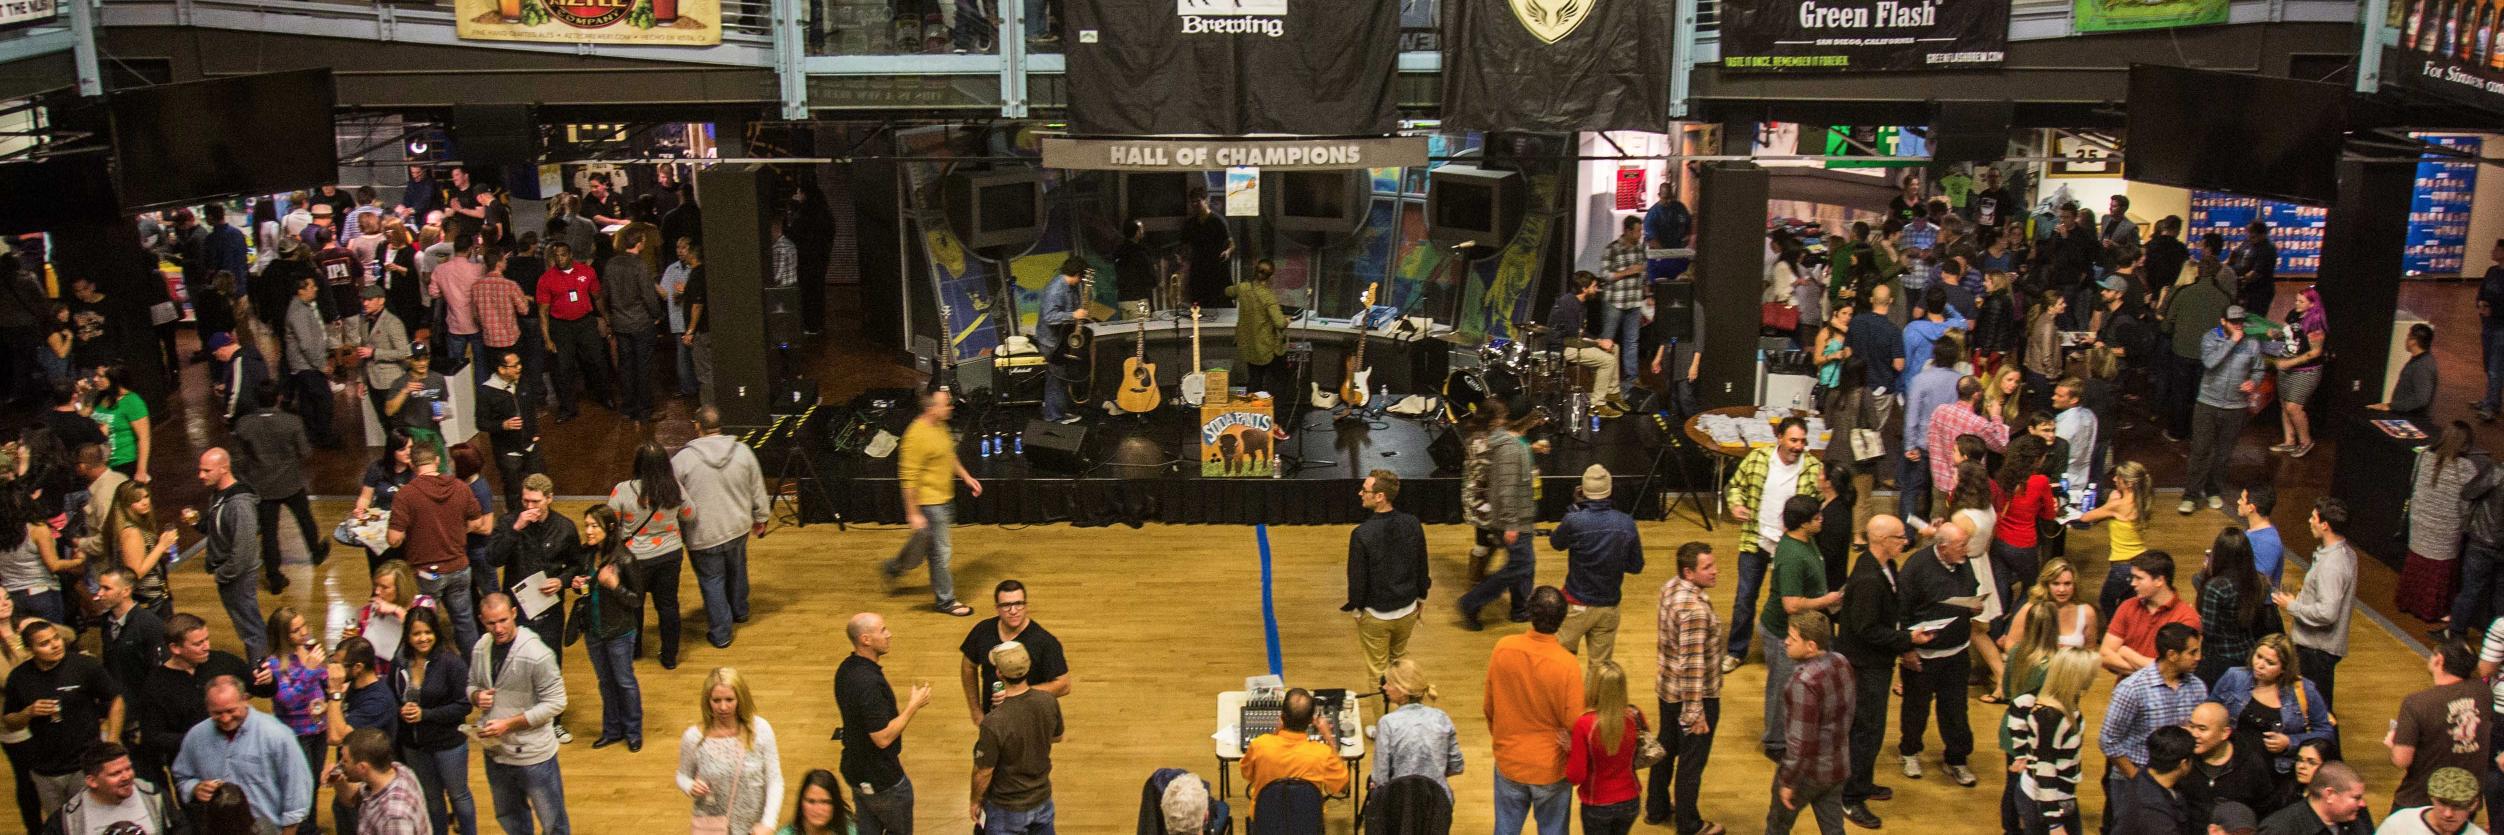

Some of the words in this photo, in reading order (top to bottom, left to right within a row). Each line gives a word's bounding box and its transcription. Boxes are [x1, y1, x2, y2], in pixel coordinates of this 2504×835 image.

[556, 9, 620, 25] COMPANY
[1799, 0, 1869, 28] Green
[1874, 0, 1936, 27] Flash
[1182, 15, 1284, 37] Brewing
[1816, 38, 1833, 46] SAN
[1834, 38, 1864, 47] DIEGO,
[1864, 37, 1915, 46] CALIFORNIA
[2423, 61, 2443, 78] For
[1110, 146, 1168, 165] HALL
[1176, 147, 1208, 165] OF
[1216, 146, 1360, 166] CHAMPIONS
[2076, 149, 2097, 163] 25
[326, 263, 349, 279] IPA
[1202, 413, 1235, 444] SODA
[1235, 412, 1272, 432] PANTS
